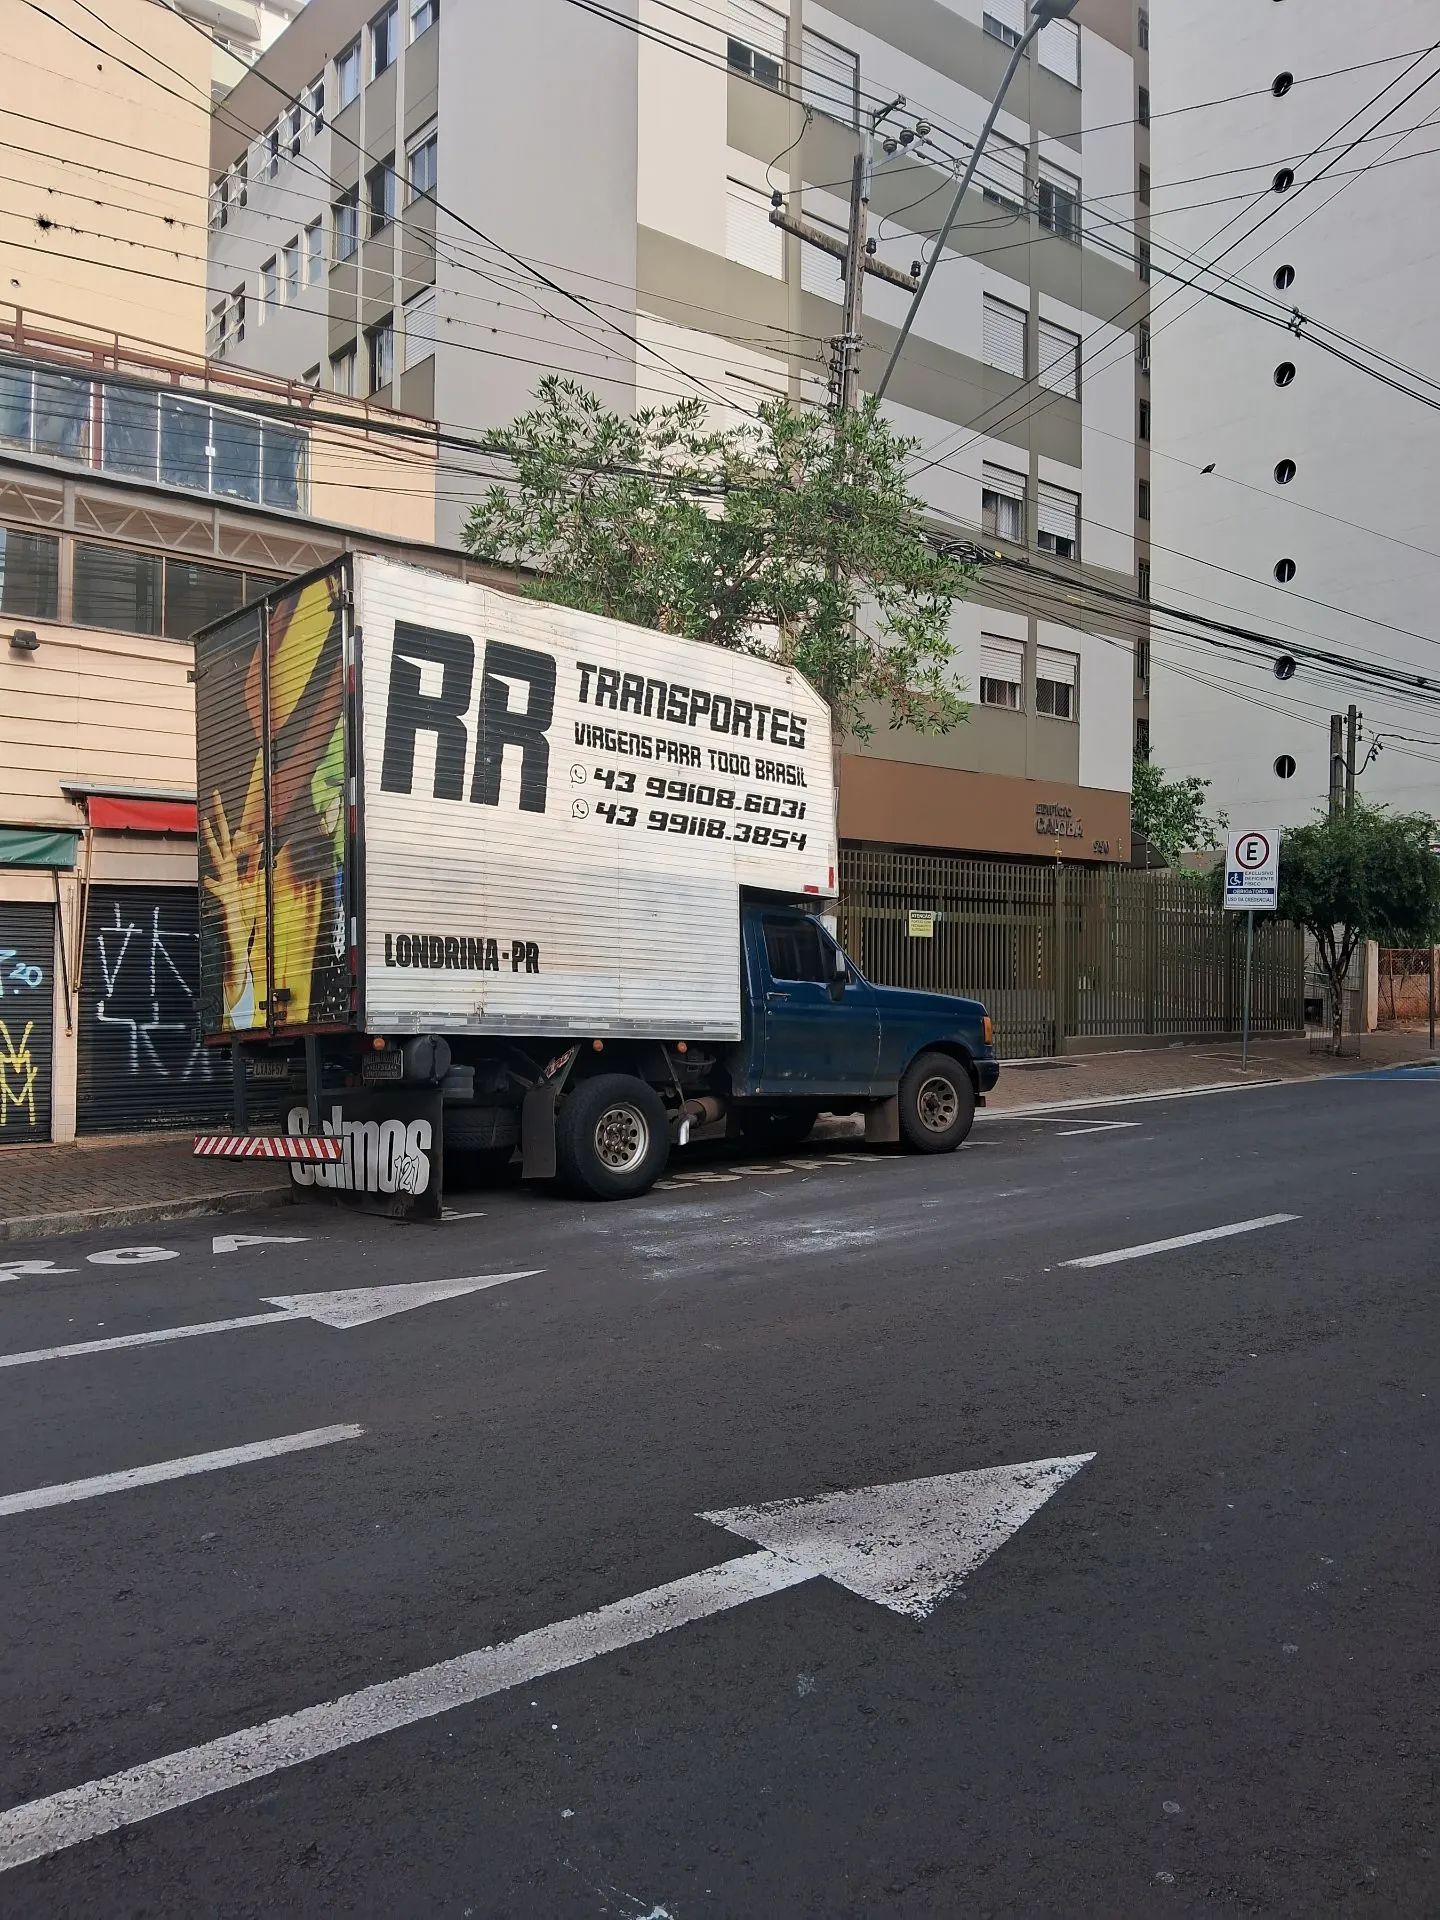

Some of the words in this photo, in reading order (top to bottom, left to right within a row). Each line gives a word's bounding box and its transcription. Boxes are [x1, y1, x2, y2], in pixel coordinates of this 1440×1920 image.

[380, 619, 556, 814] RR
[576, 661, 808, 749] TRANSPORTES
[574, 721, 653, 759] VIAGENS
[655, 738, 702, 768] PARA
[708, 749, 750, 778] TODO
[755, 758, 808, 788] BRASIL
[593, 767, 637, 793] 43
[645, 776, 807, 820] 99108.6031
[595, 801, 639, 827] 43
[646, 809, 808, 852] 99118.3854
[1247, 842, 1258, 860] E
